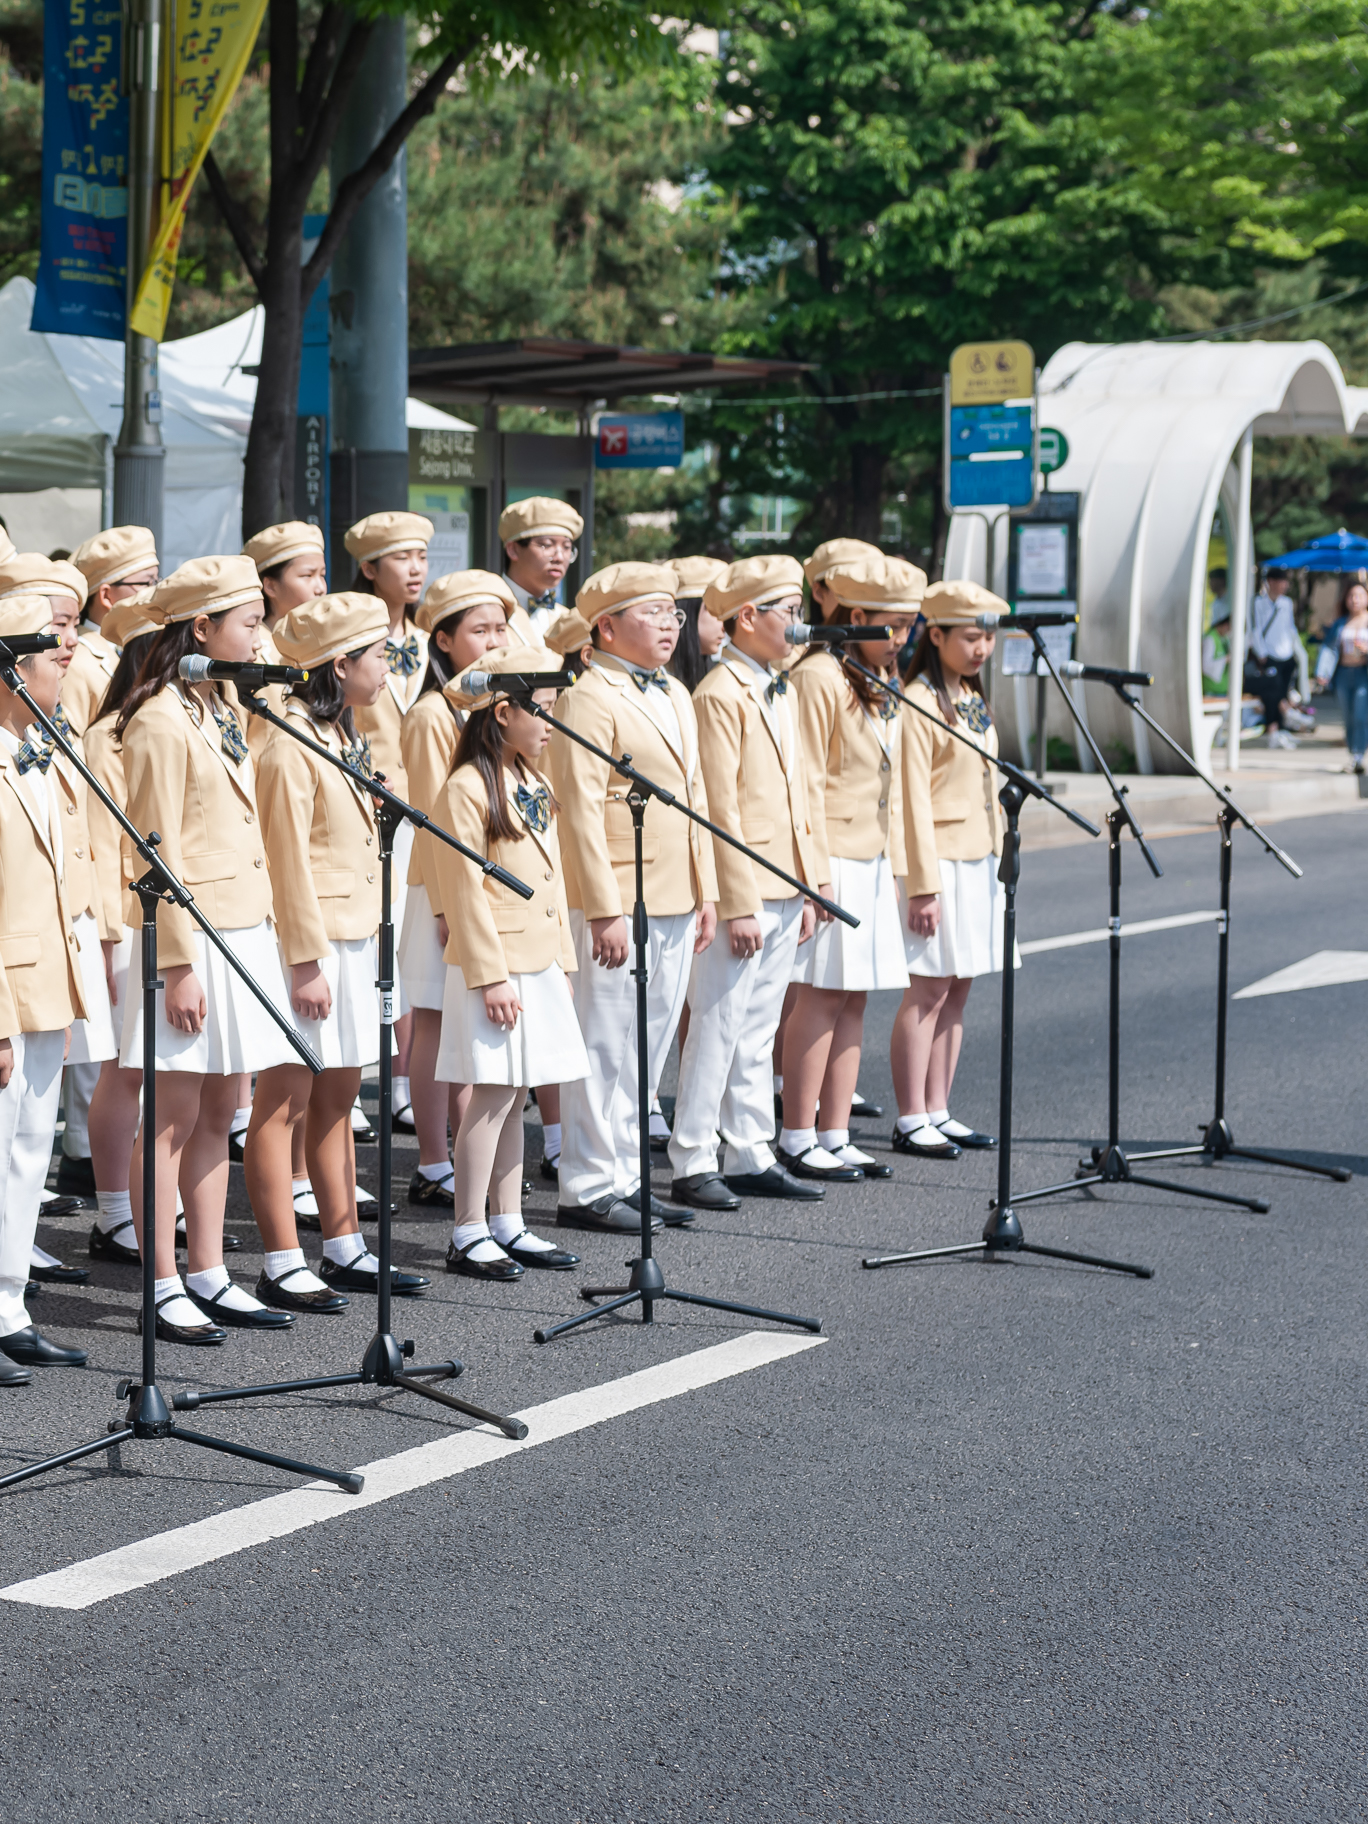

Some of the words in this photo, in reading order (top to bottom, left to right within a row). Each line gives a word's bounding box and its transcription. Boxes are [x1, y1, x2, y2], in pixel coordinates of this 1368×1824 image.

[305, 416, 321, 506] AIRPORT
[419, 455, 450, 480] Sejong
[452, 458, 475, 479] Univ.
